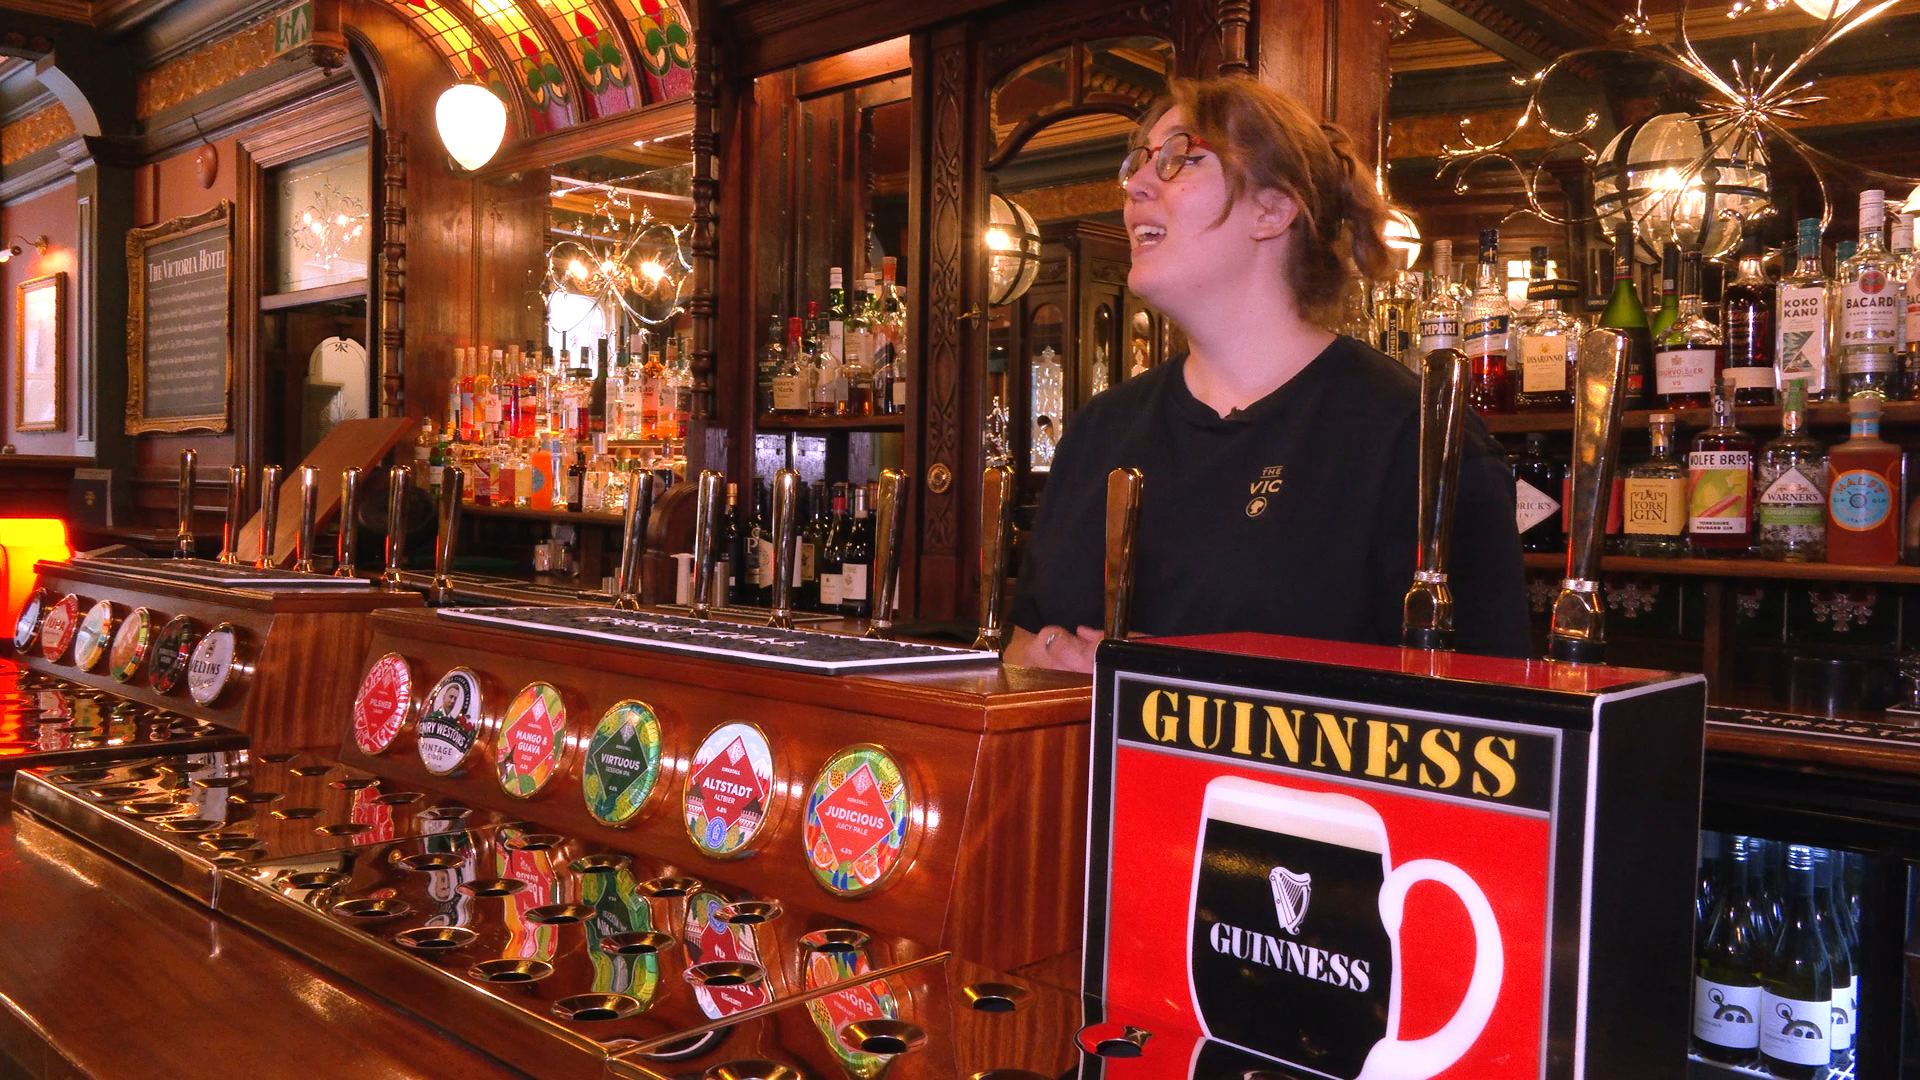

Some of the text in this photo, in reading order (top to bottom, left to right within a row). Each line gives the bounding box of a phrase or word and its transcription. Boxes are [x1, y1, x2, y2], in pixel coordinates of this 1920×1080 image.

[148, 249, 227, 283] THE VICTORIA HOTEL
[1784, 298, 1818, 308] KOKO
[1783, 308, 1818, 318] KANU
[1420, 323, 1456, 336] AMPARI
[1526, 355, 1563, 364] DISARONNO
[1690, 454, 1715, 465] WOLFE
[1262, 467, 1282, 477] THE
[1250, 480, 1283, 495] VIC
[1633, 501, 1664, 512] YORK
[1634, 510, 1662, 520] GIN
[436, 723, 466, 748] WESTONS
[516, 730, 548, 746] MANGO &
[421, 742, 452, 756] VINTAGE
[518, 742, 540, 755] GUAVA
[1140, 688, 1518, 798] GUINNESS
[601, 753, 640, 770] VIRTUOUS
[702, 777, 753, 799] ALTSTADT
[714, 793, 736, 805] ALTBIER
[824, 806, 884, 829] JUDICIOUS
[836, 822, 868, 836] JUICY PALE
[1209, 921, 1372, 994] GUINNESS
